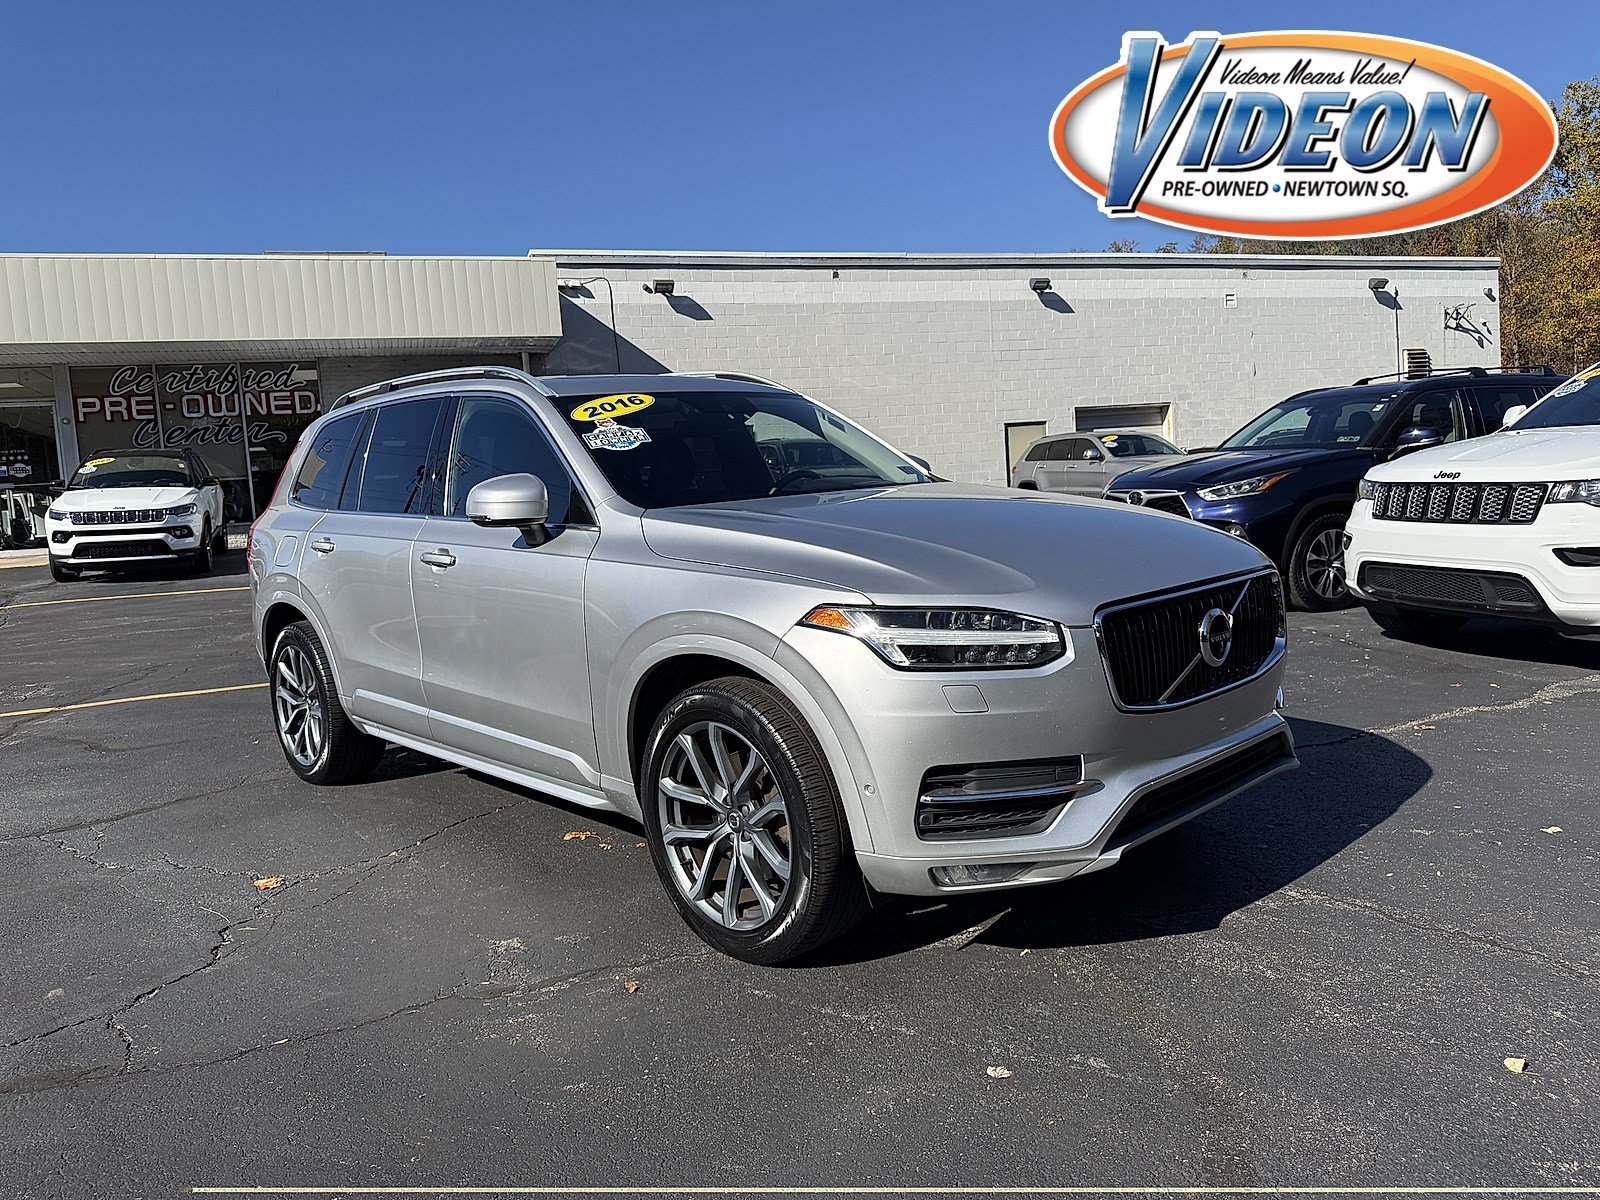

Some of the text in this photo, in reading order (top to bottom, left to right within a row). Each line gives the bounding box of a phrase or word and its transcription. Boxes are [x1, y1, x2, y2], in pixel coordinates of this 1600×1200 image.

[109, 364, 307, 396] Certified
[583, 396, 645, 418] 2016
[133, 417, 287, 448] Center
[1433, 470, 1461, 481] Jeep
